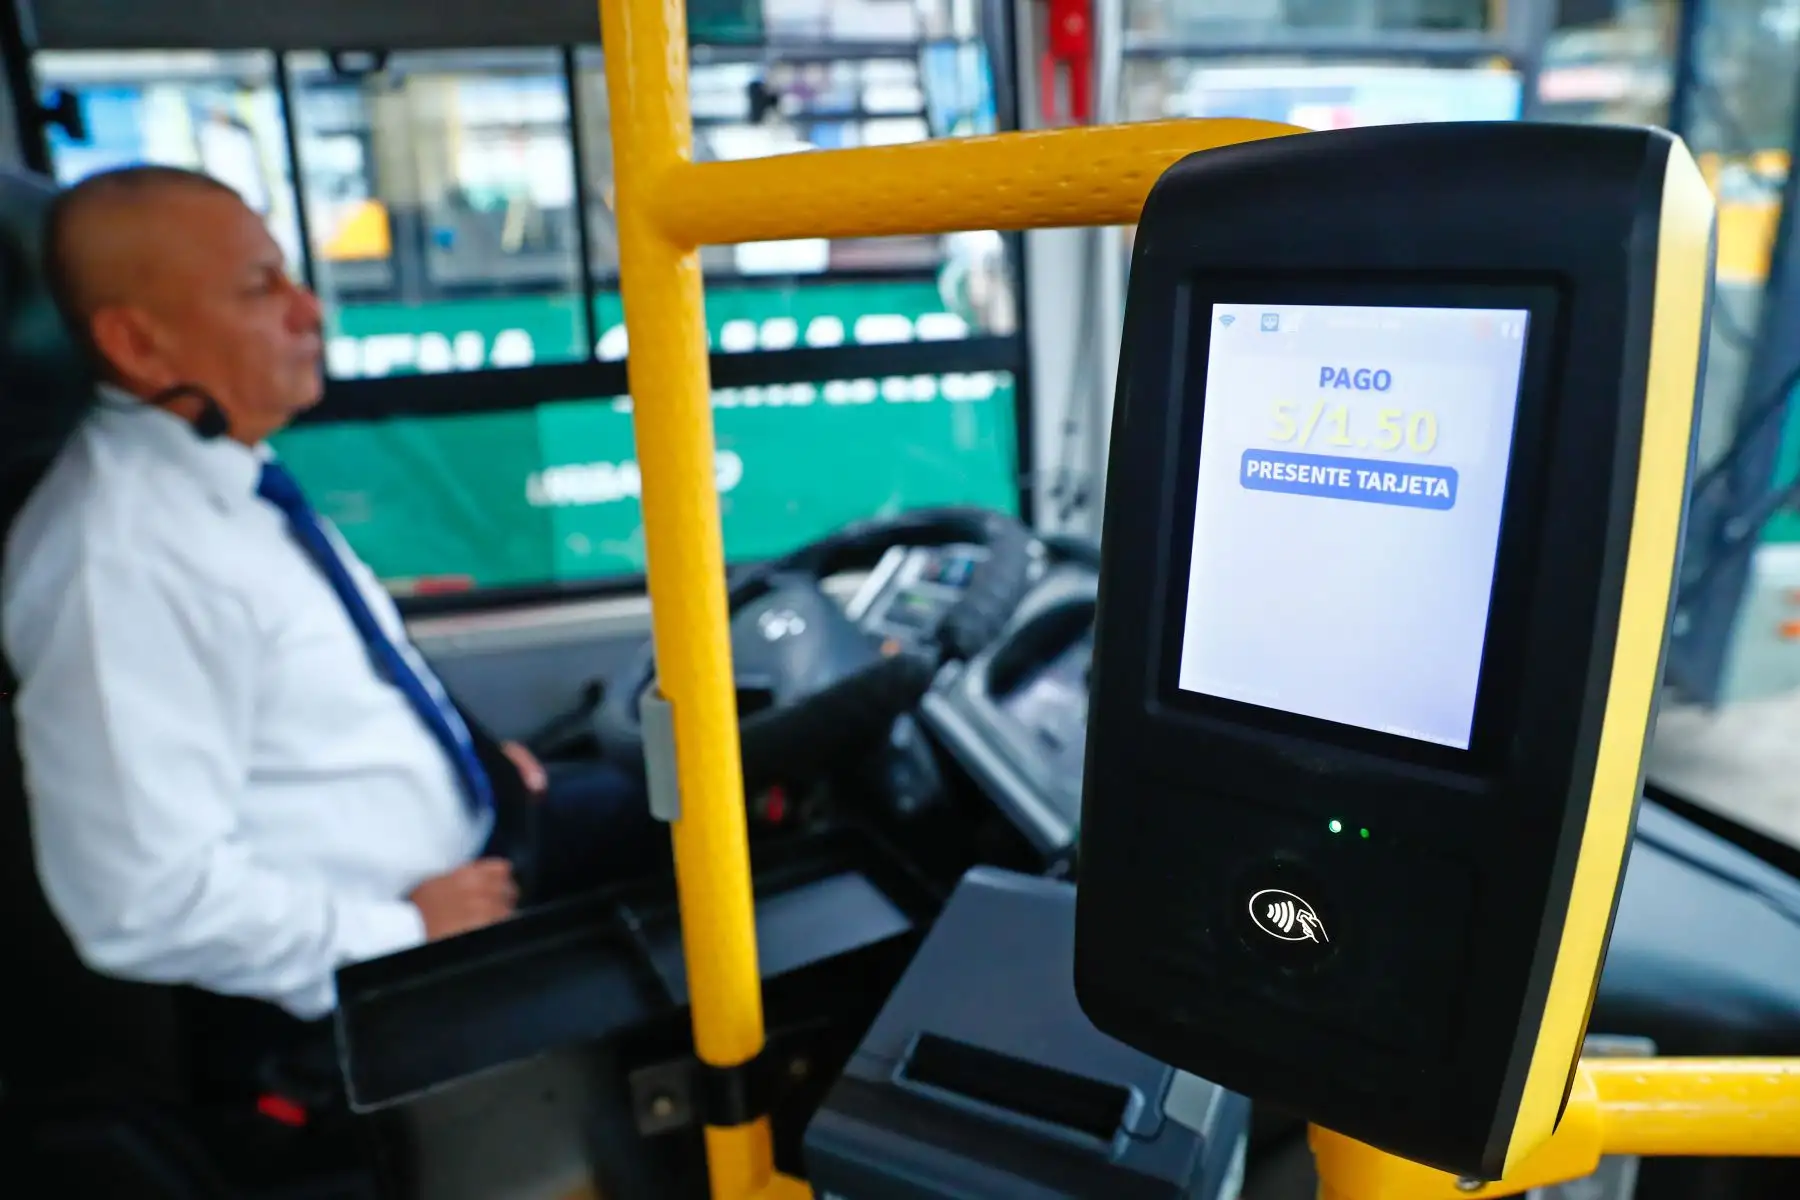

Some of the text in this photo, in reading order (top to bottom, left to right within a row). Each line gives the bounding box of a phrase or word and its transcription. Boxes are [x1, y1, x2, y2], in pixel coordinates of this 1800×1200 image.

[1318, 366, 1392, 392] PAGO
[1267, 398, 1437, 454] S/1.50
[1246, 459, 1450, 498] PRESENTE TARJETA
